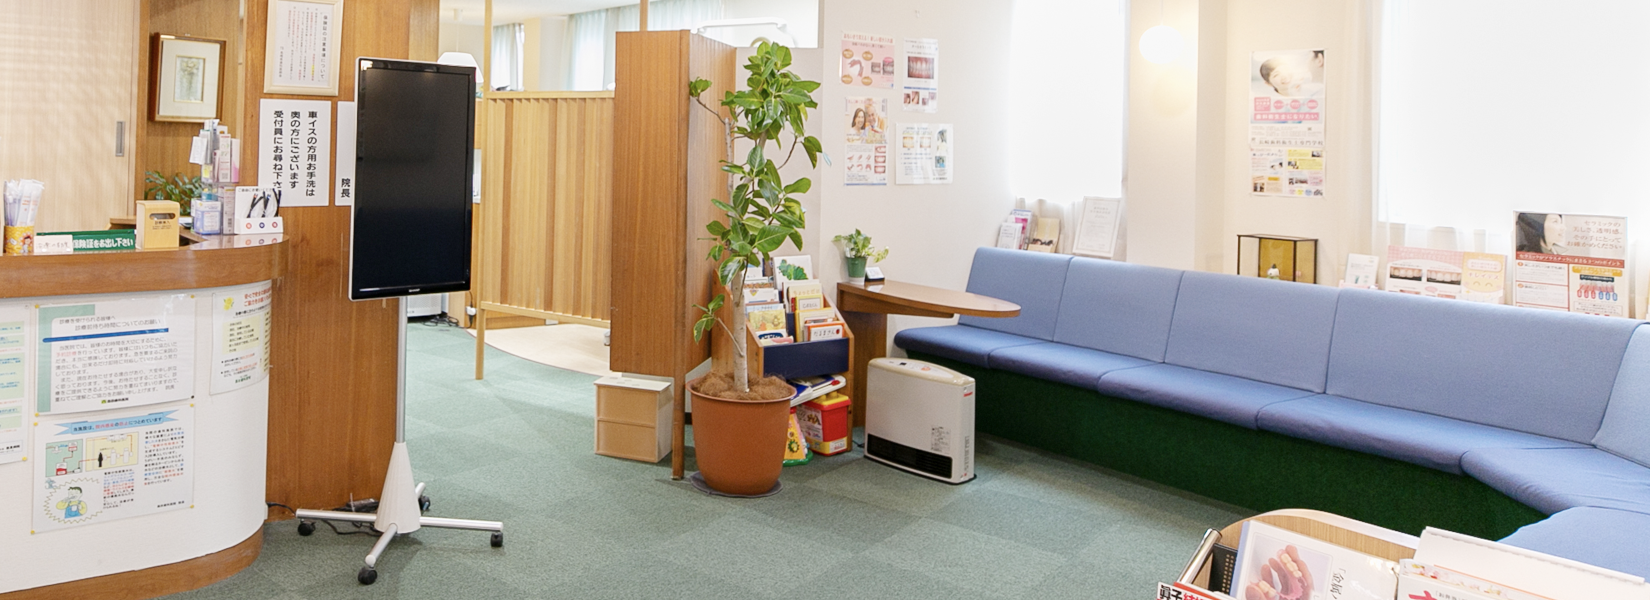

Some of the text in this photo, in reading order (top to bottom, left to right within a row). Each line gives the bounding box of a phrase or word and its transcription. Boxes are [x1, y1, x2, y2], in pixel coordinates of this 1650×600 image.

[272, 110, 284, 189] 受付員にお尋ね下さ
[289, 111, 301, 188] 奥の方にございます
[306, 110, 318, 196] 車イスの方用お手洗は
[340, 178, 351, 198] 院長
[1572, 226, 1623, 235] 美しさ、透明感。
[1573, 234, 1622, 244] その手にとって
[73, 237, 134, 249] 保険証をお出し下さい
